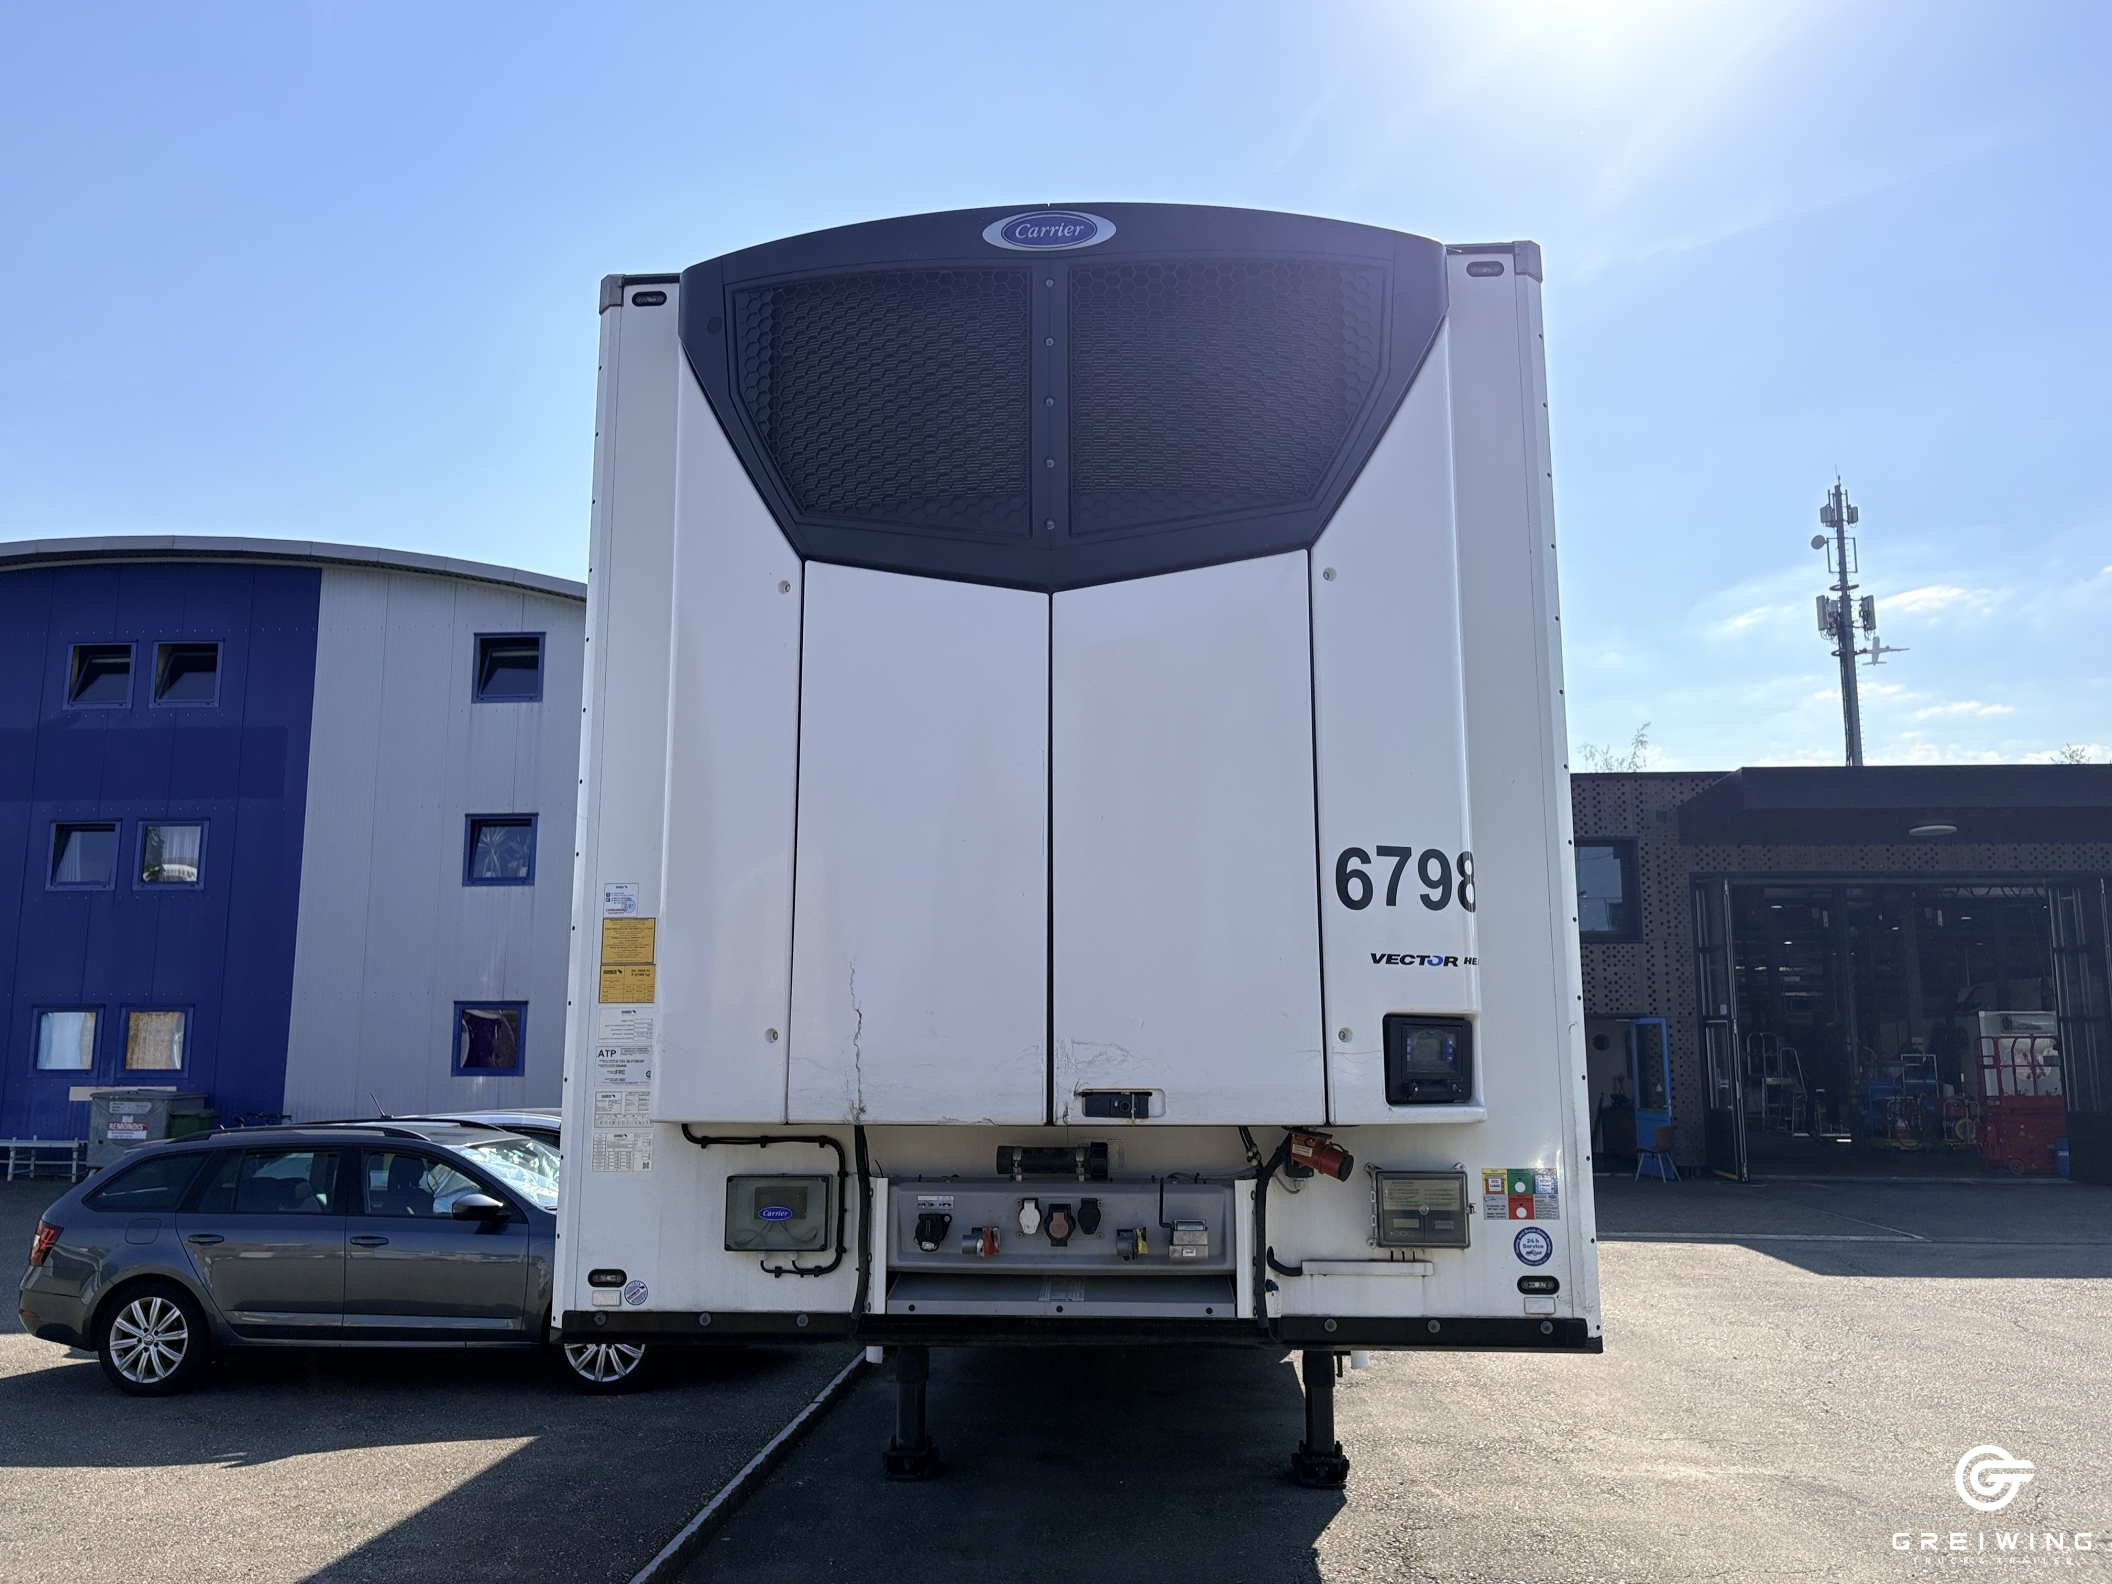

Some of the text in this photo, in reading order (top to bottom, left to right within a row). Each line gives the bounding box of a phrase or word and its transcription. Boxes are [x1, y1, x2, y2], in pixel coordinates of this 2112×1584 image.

[1015, 222, 1085, 239] Carrier
[1335, 845, 1477, 913] 6798
[1370, 953, 1480, 967] VECTOR HE
[598, 1049, 617, 1058] ATP
[762, 1209, 789, 1217] Carrier
